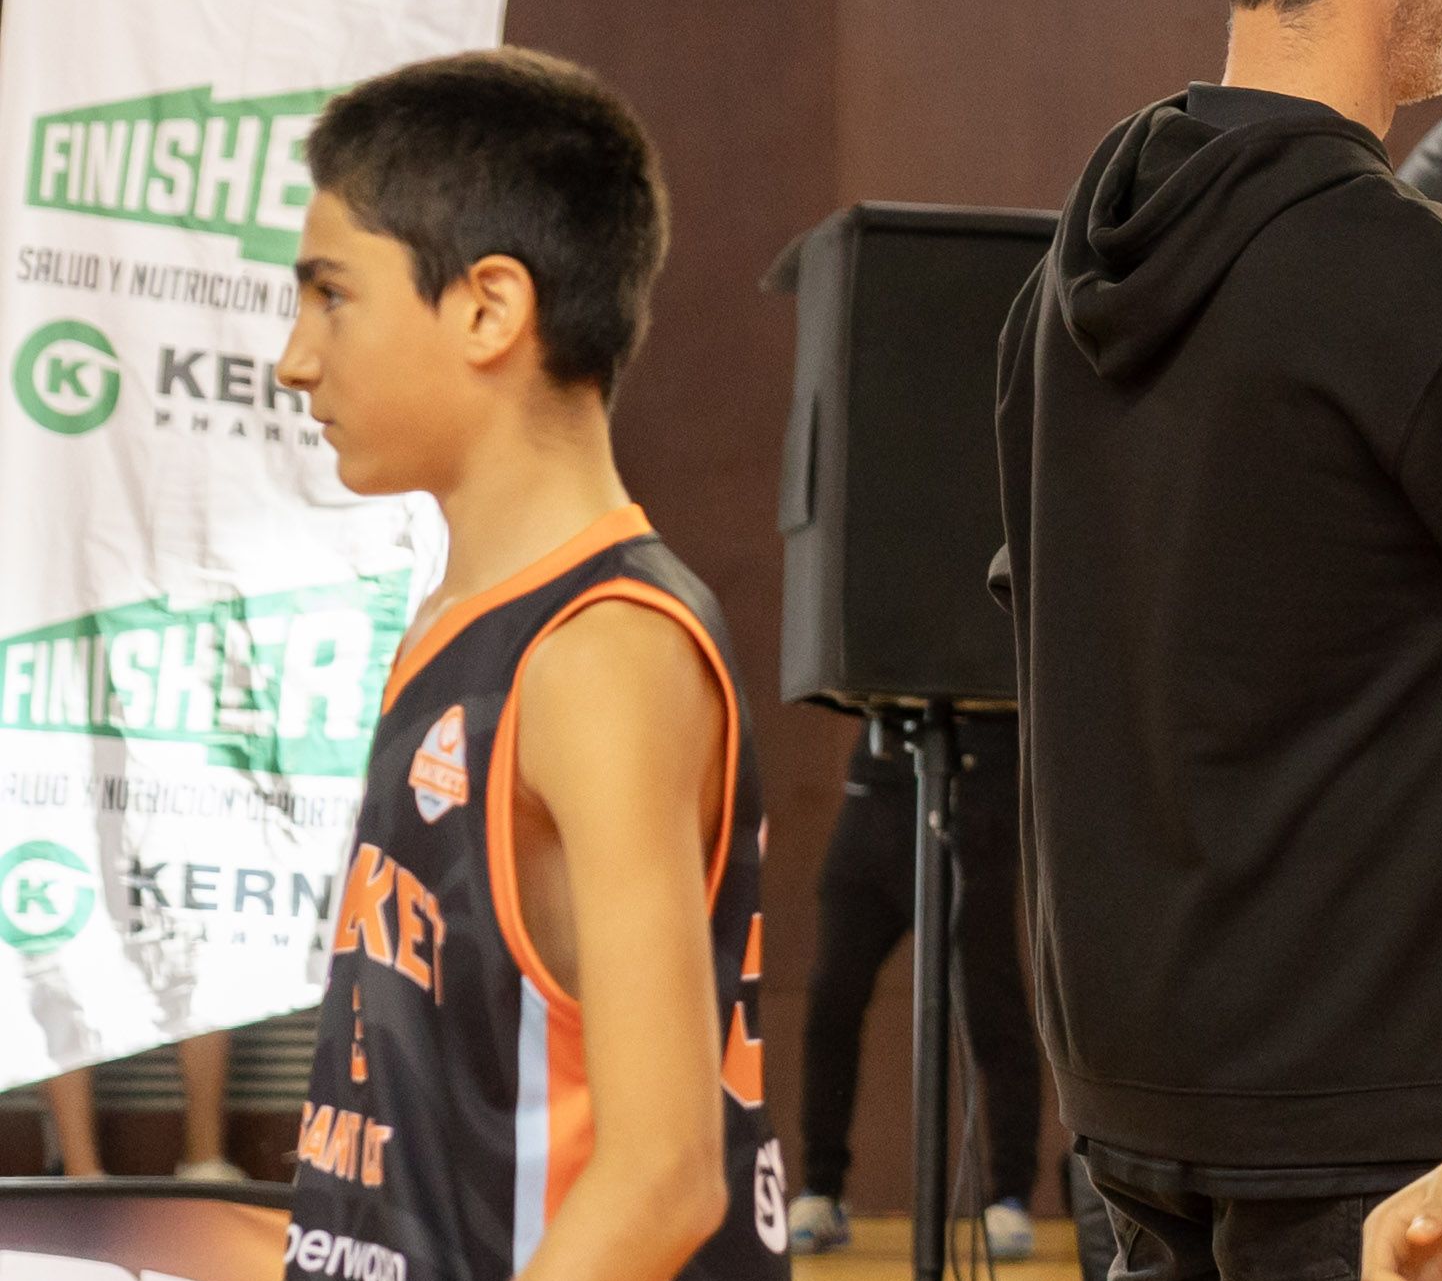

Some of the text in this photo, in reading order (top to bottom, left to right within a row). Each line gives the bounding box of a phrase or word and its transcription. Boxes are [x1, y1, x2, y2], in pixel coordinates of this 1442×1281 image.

[39, 112, 320, 232] FINISHE
[18, 245, 98, 289] SALUD
[107, 257, 122, 290] Y
[157, 346, 304, 414] KER
[155, 411, 321, 447] PHARM
[125, 854, 335, 921] KERN
